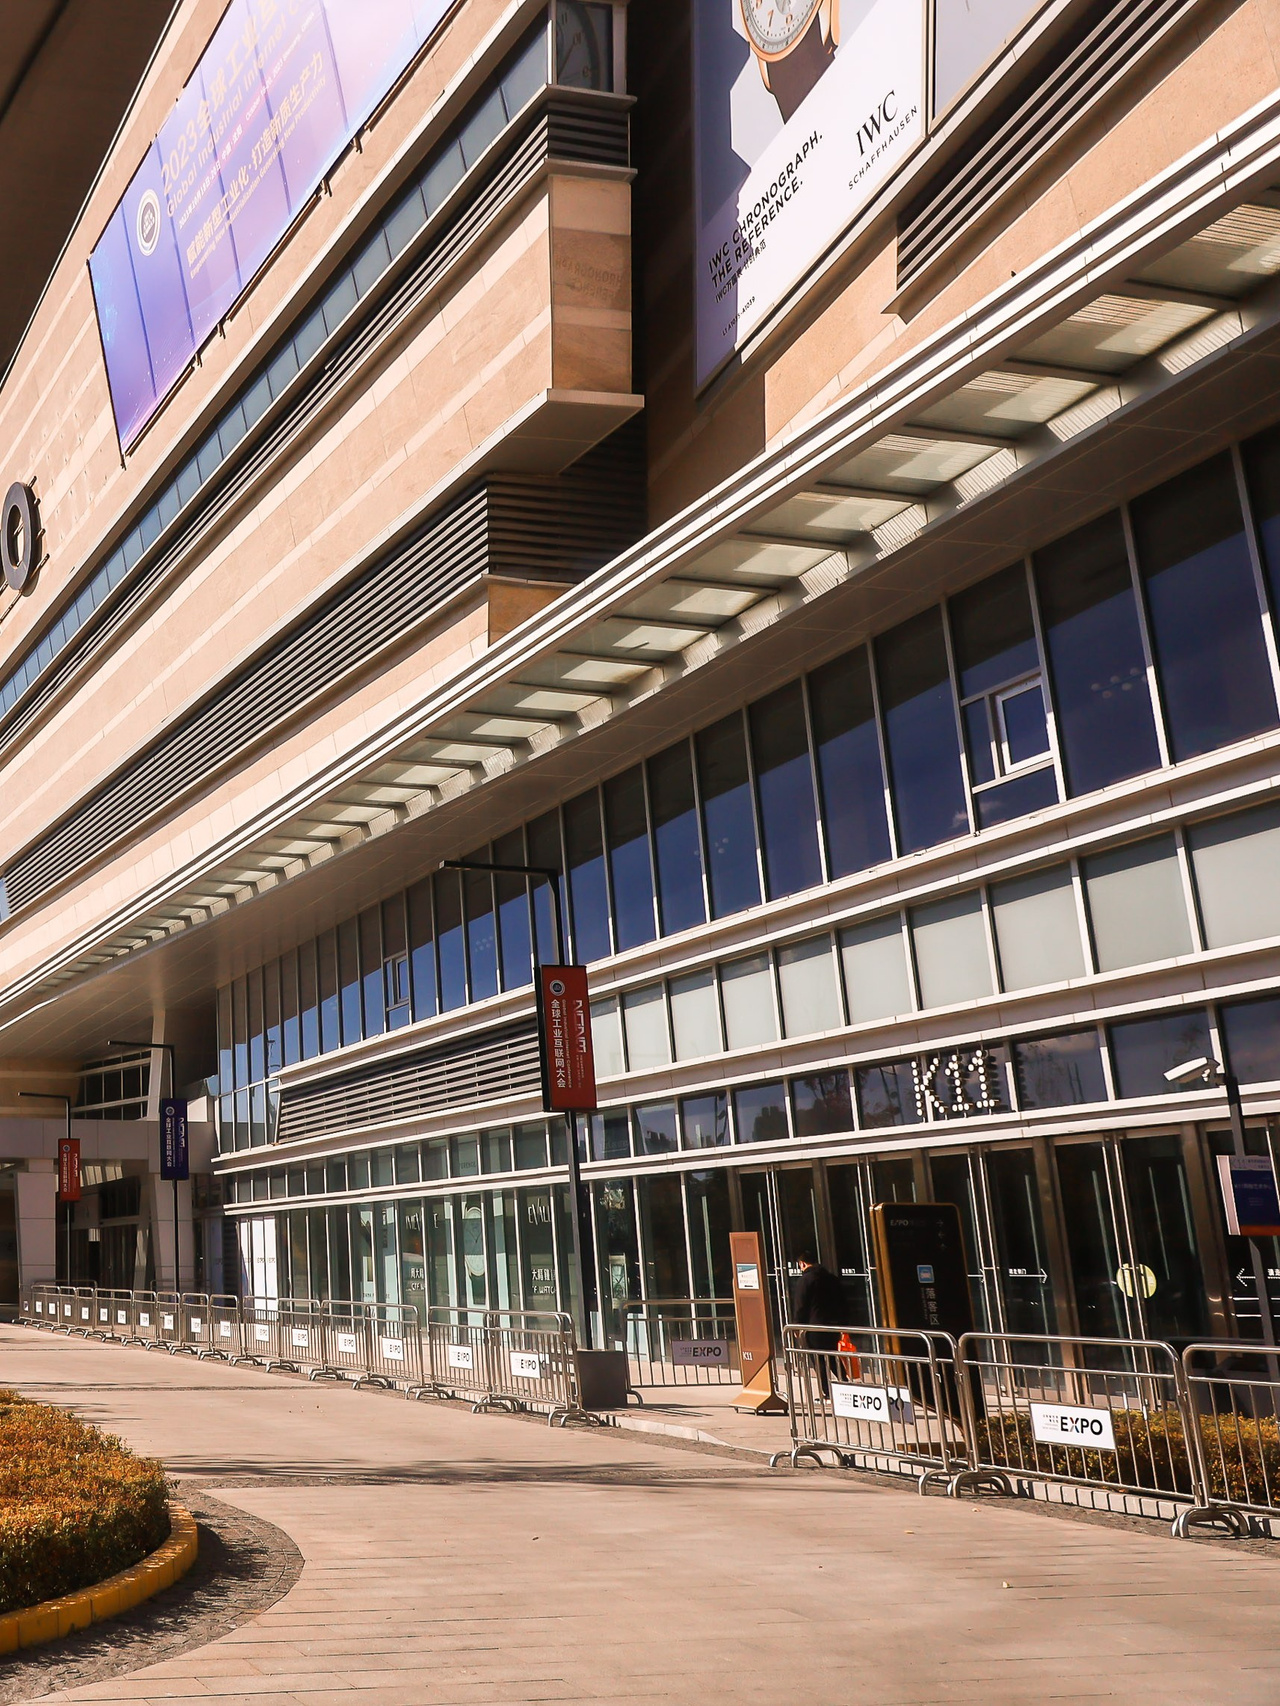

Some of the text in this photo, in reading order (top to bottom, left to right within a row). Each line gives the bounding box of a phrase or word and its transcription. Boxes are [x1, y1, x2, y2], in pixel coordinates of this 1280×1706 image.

[167, 13, 287, 218] Global Industrial Internet
[848, 105, 918, 190] SCHAFFHAUSEN
[856, 89, 898, 156] IWC
[708, 130, 823, 273] IWC CHRONOGRAPH.
[711, 179, 804, 288] THE REFERENCE.
[551, 998, 566, 1088] 全球工业互联网大会
[911, 1049, 1000, 1117] K11
[457, 1351, 470, 1362] EXPO
[520, 1355, 537, 1371] EXPO
[692, 1346, 722, 1357] EXPO
[742, 1351, 753, 1361] K11
[852, 1394, 882, 1411] EXPO
[1060, 1415, 1103, 1436] EXPO
